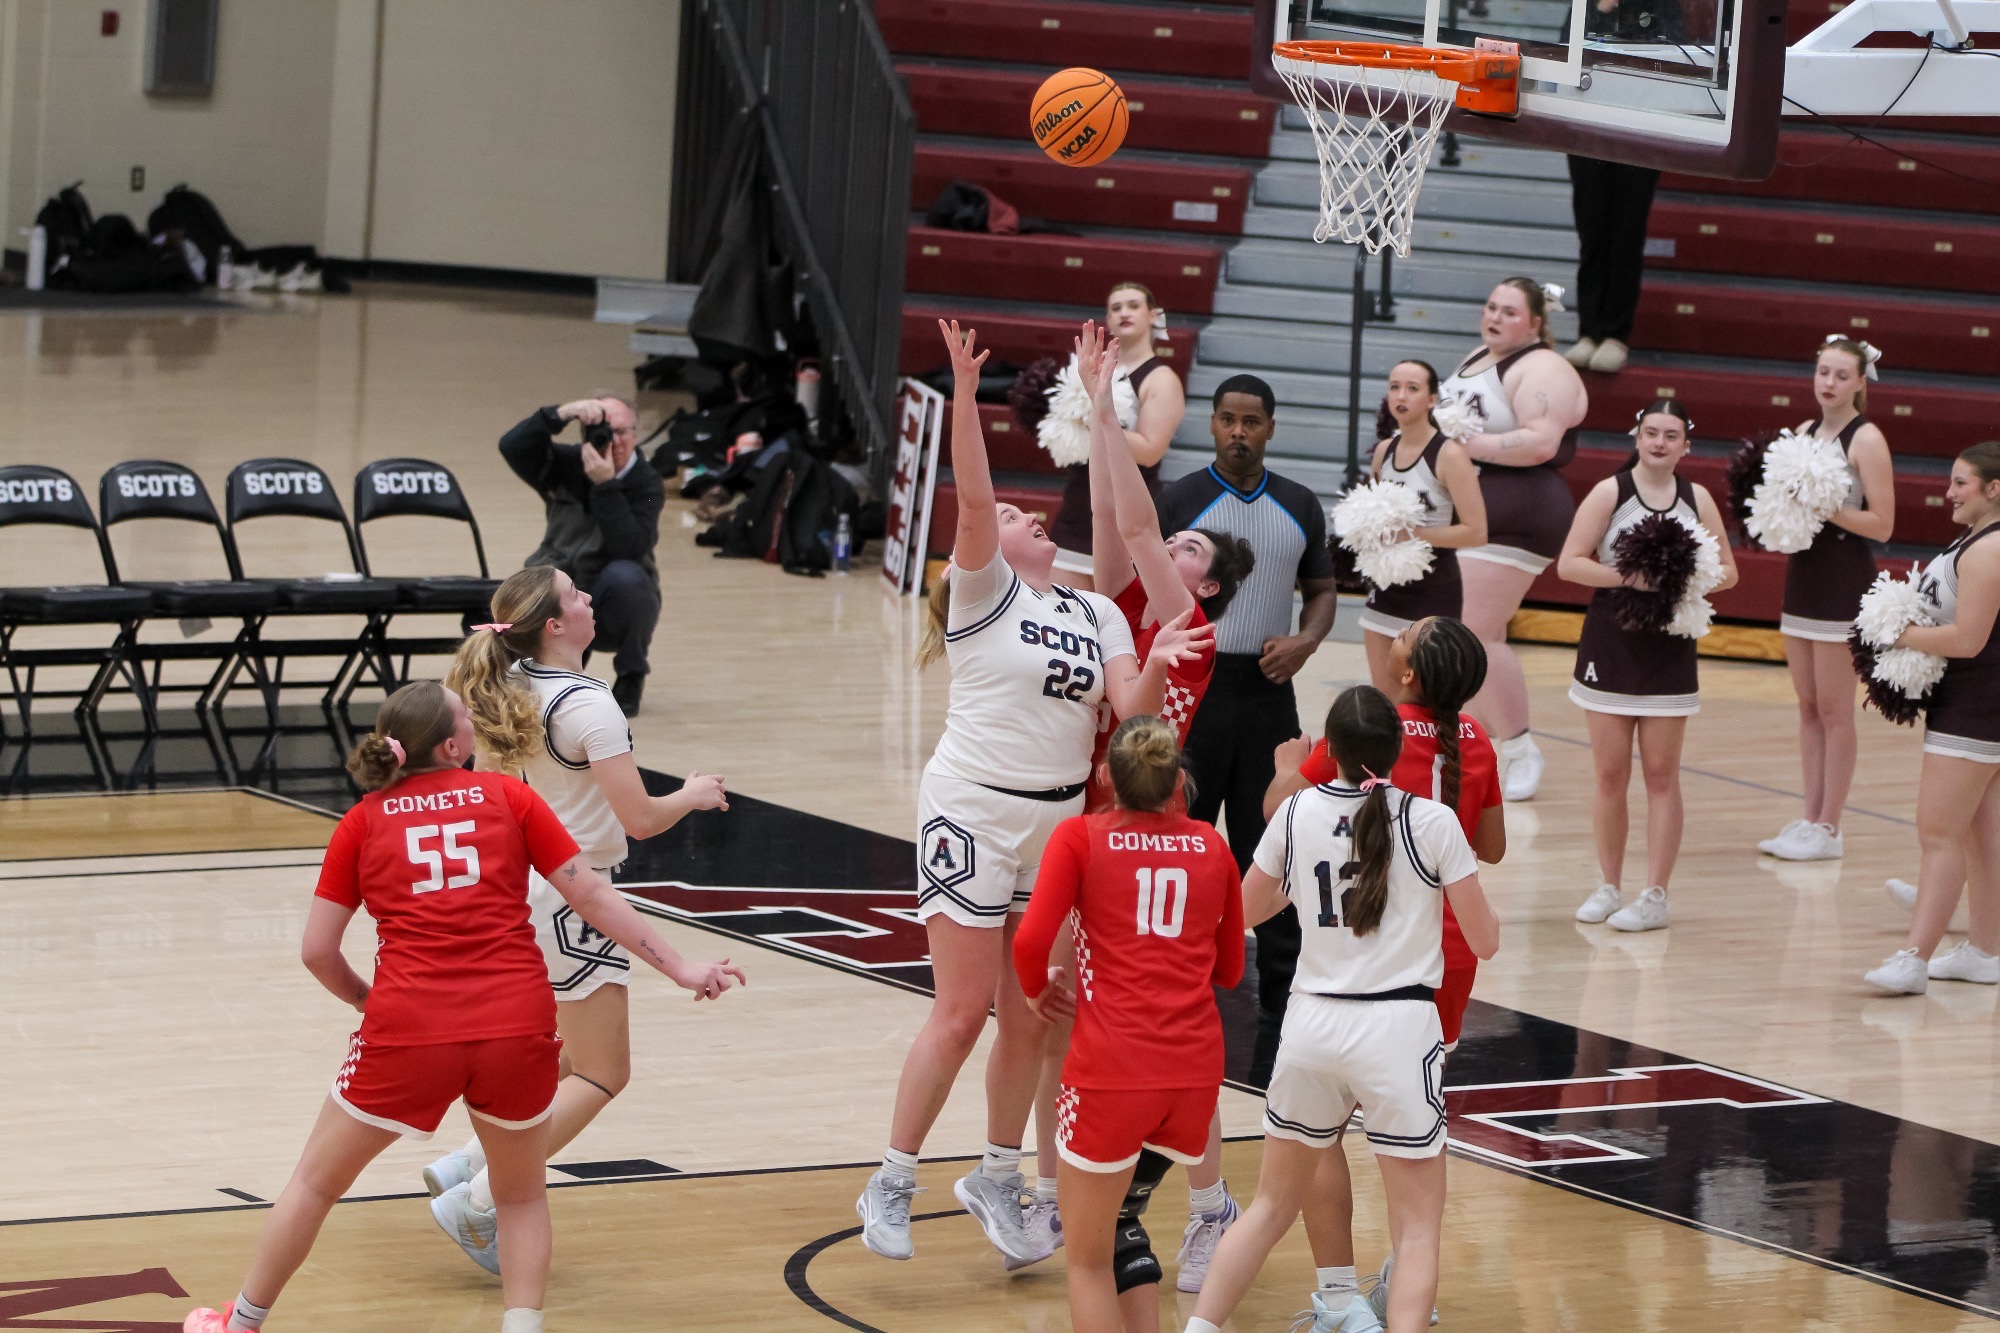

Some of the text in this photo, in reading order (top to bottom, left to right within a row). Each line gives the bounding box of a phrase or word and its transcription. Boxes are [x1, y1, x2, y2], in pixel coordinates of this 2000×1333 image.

[1034, 100, 1083, 141] Wilson
[1058, 125, 1098, 159] NCAA
[118, 474, 197, 497] SCOTS
[244, 472, 323, 495] SCOTS
[372, 472, 451, 494] SCOTS
[1042, 658, 1095, 702] 22
[1584, 661, 1599, 682] A
[1403, 720, 1476, 739] COMTS
[383, 786, 485, 815] COMETS
[405, 819, 481, 895] 55
[929, 835, 957, 871] A
[1108, 832, 1206, 853] COMETS
[1135, 867, 1188, 938] 10
